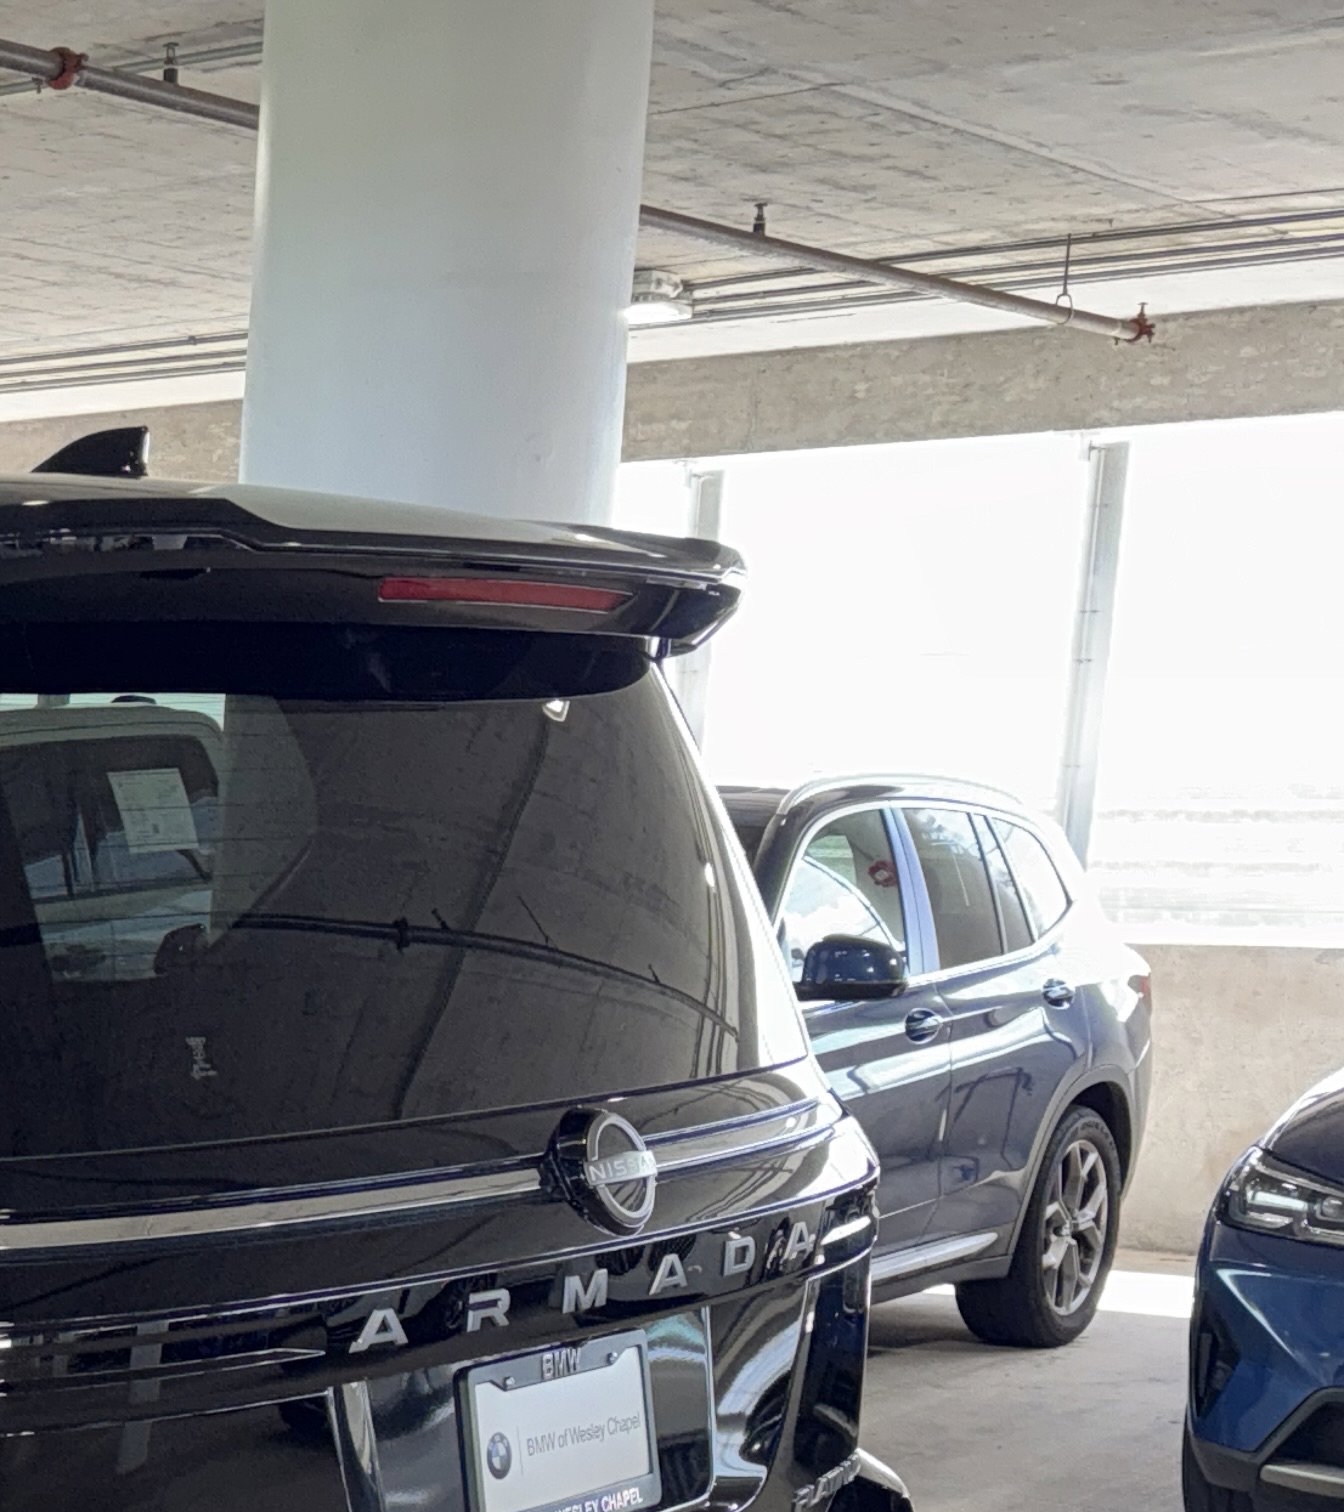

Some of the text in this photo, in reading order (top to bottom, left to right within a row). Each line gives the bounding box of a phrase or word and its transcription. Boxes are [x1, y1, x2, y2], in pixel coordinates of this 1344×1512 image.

[348, 1221, 813, 1354] ARMADA
[541, 1347, 581, 1379] BMW
[526, 1432, 556, 1456] BMW
[557, 1430, 570, 1449] of
[569, 1422, 606, 1446] Wesley
[607, 1412, 641, 1440] Chapel
[601, 1487, 644, 1512] CHAPEL
